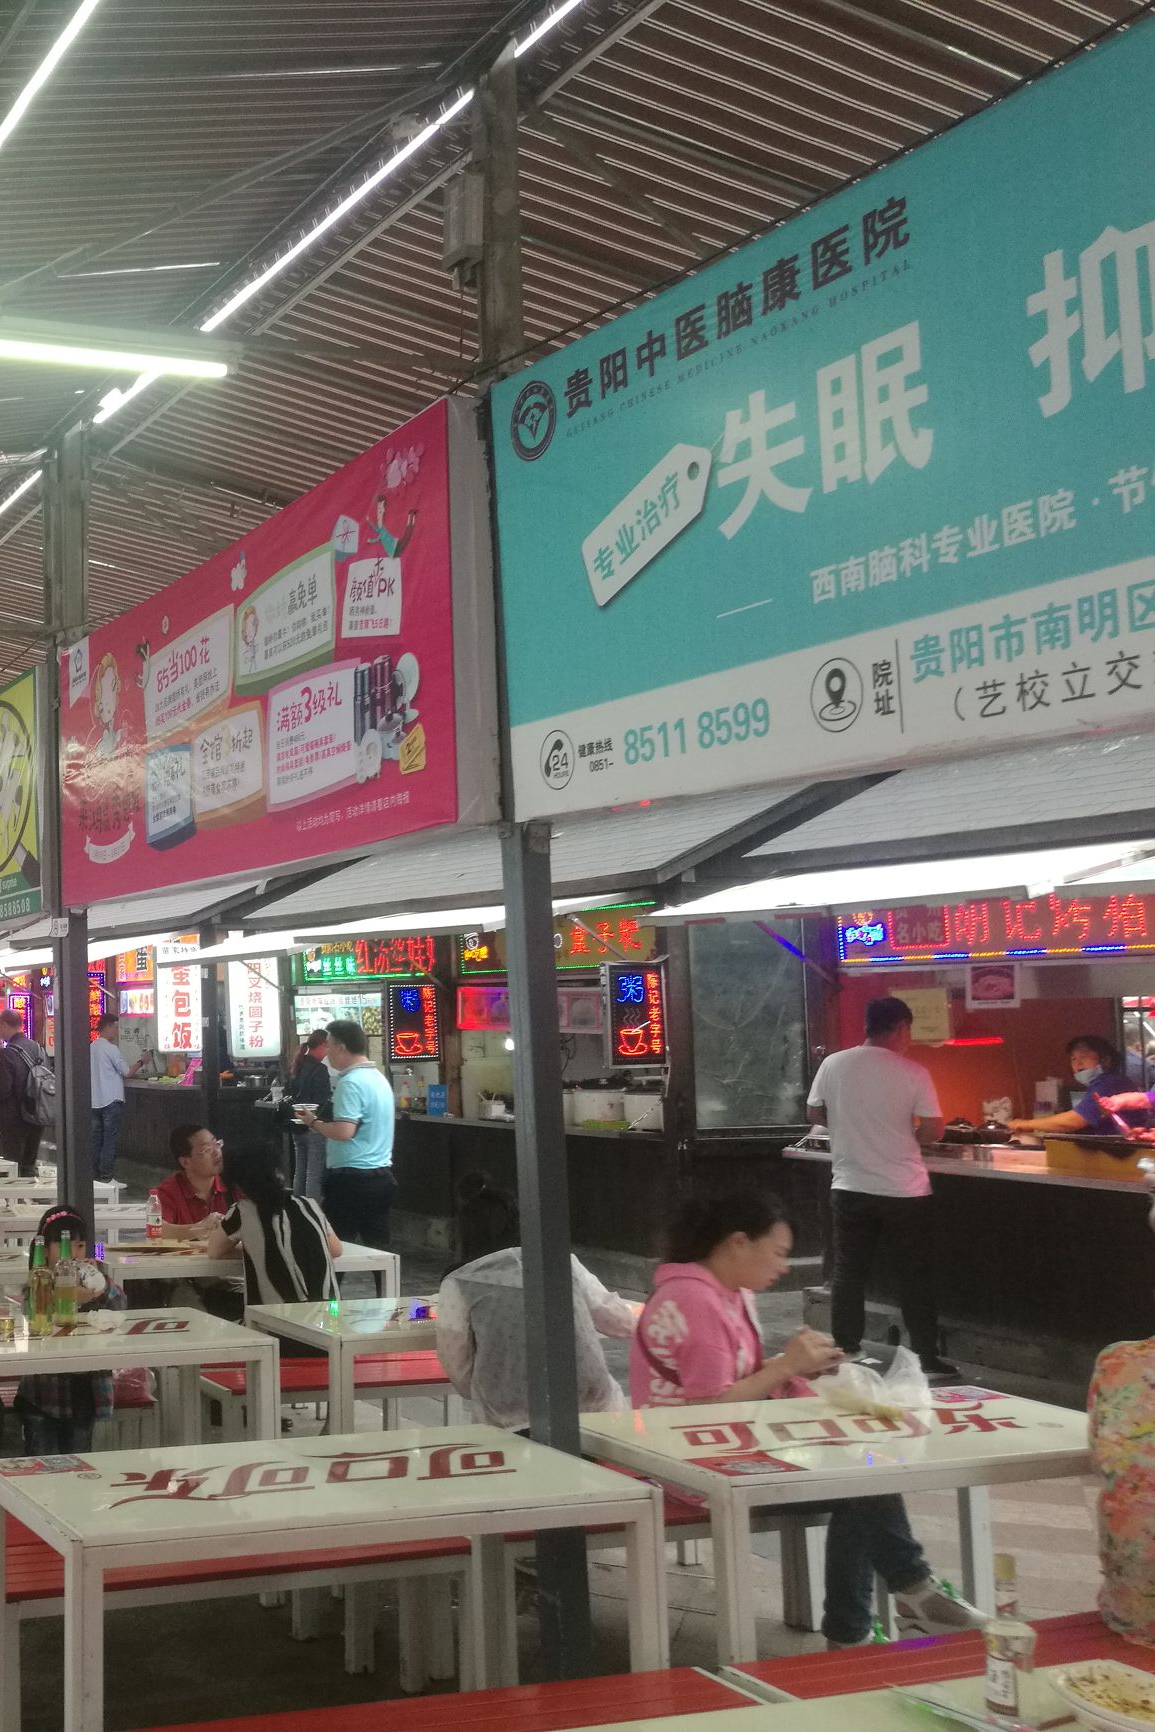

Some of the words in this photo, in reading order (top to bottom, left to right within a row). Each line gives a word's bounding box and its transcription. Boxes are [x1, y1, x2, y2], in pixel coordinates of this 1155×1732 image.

[563, 196, 912, 419] 贵阳中医脑康医院
[828, 259, 912, 305] HOSPITAL
[716, 320, 935, 541] 失眠
[592, 470, 682, 581] 专业治疗
[909, 579, 1155, 684] 贵阳市南明区
[277, 681, 343, 732] 满额3级礼
[871, 658, 896, 717] 院址
[552, 751, 569, 771] 24
[624, 718, 687, 766] 8511
[697, 698, 771, 750] 8599
[617, 974, 644, 1003] 粥
[646, 972, 662, 1054] 陈记老字号
